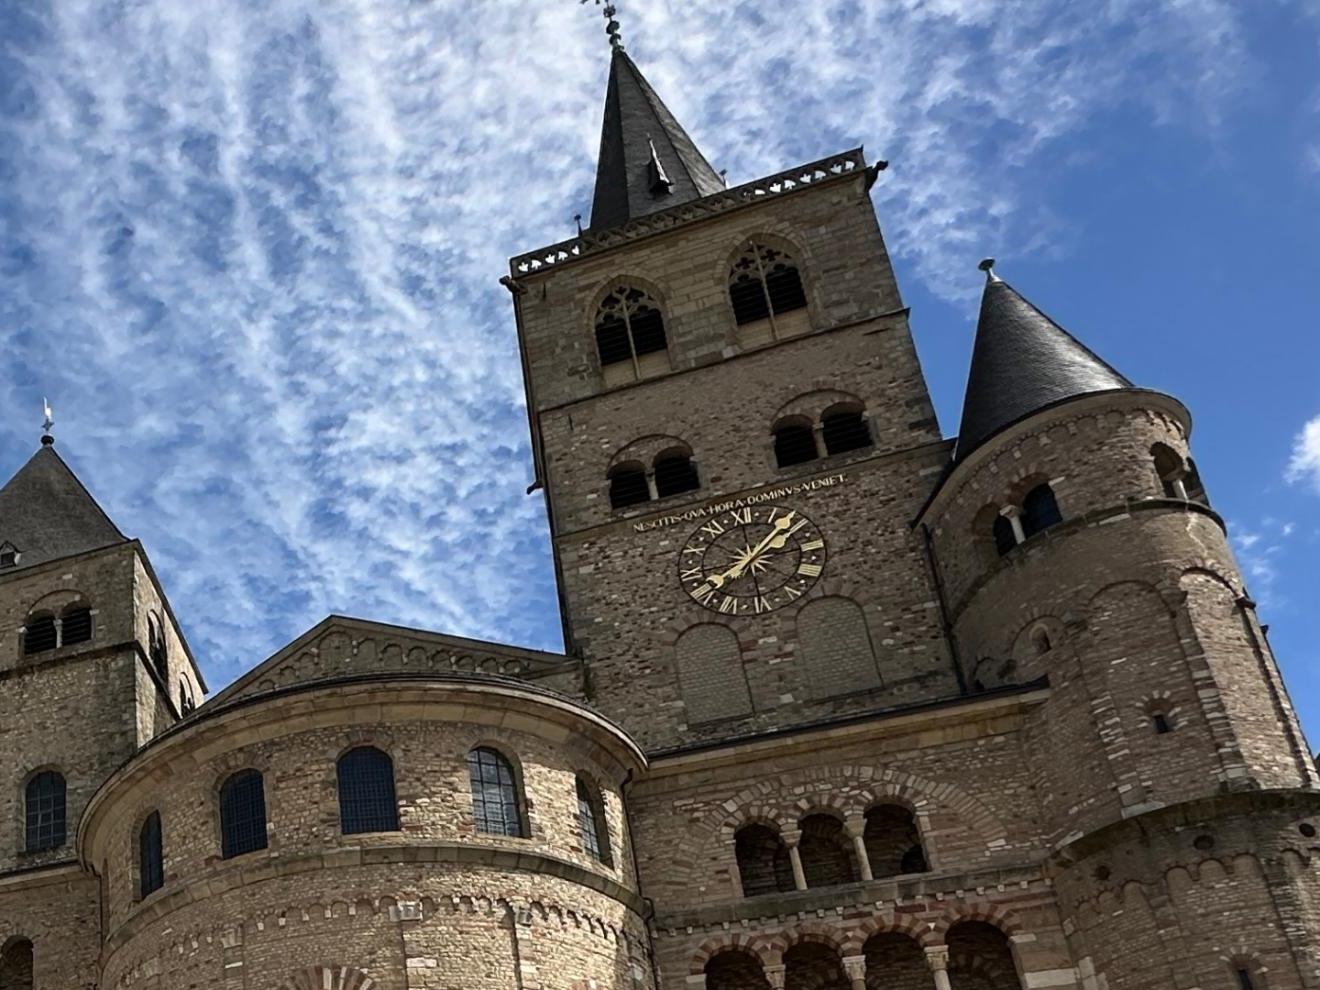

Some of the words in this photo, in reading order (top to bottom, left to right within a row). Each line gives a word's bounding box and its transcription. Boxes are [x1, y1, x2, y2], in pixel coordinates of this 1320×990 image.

[709, 499, 745, 515] HORA
[747, 486, 801, 505] DOMINVS
[731, 507, 752, 527] XII
[701, 519, 725, 539] XI
[683, 545, 706, 556] X
[801, 539, 825, 552] III
[784, 585, 802, 601] V
